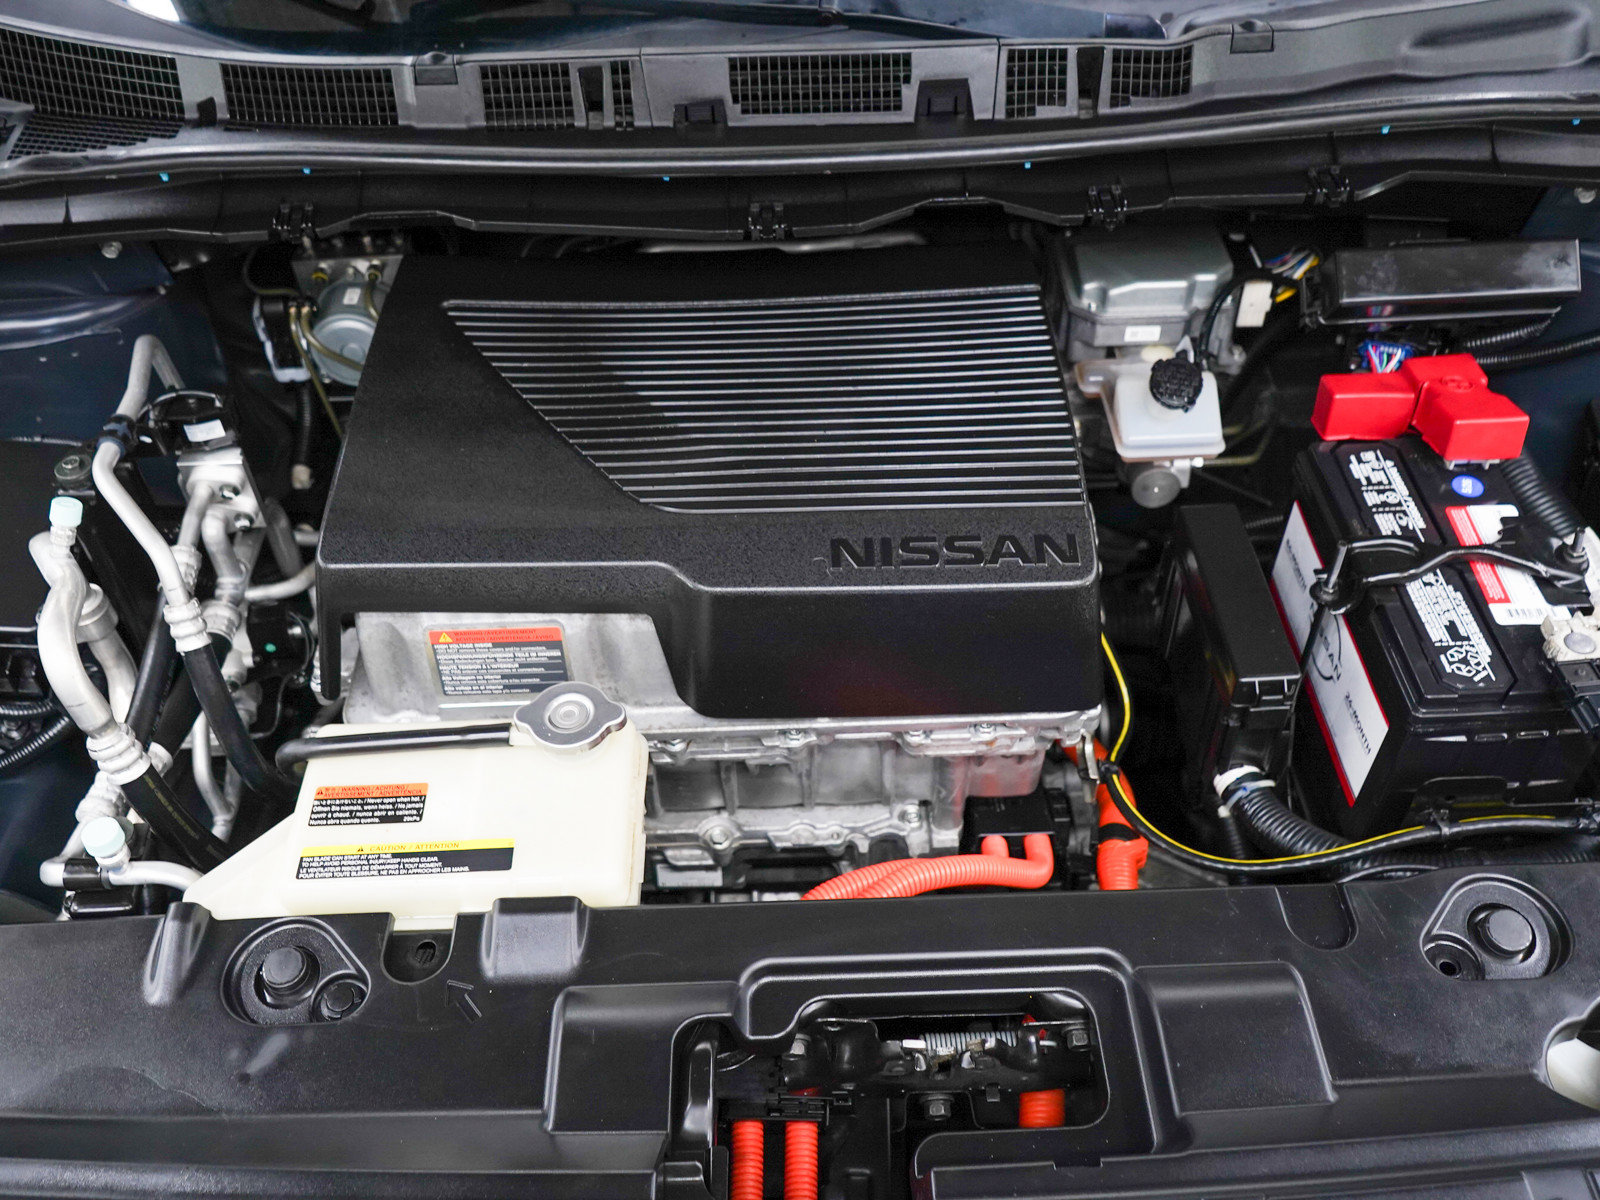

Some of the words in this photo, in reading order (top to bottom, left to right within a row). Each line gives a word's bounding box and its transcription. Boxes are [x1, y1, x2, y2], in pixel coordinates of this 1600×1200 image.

[829, 533, 1081, 571] NISSAN
[1344, 692, 1371, 754] 24-MONTH
[415, 842, 460, 850] ATTENTION
